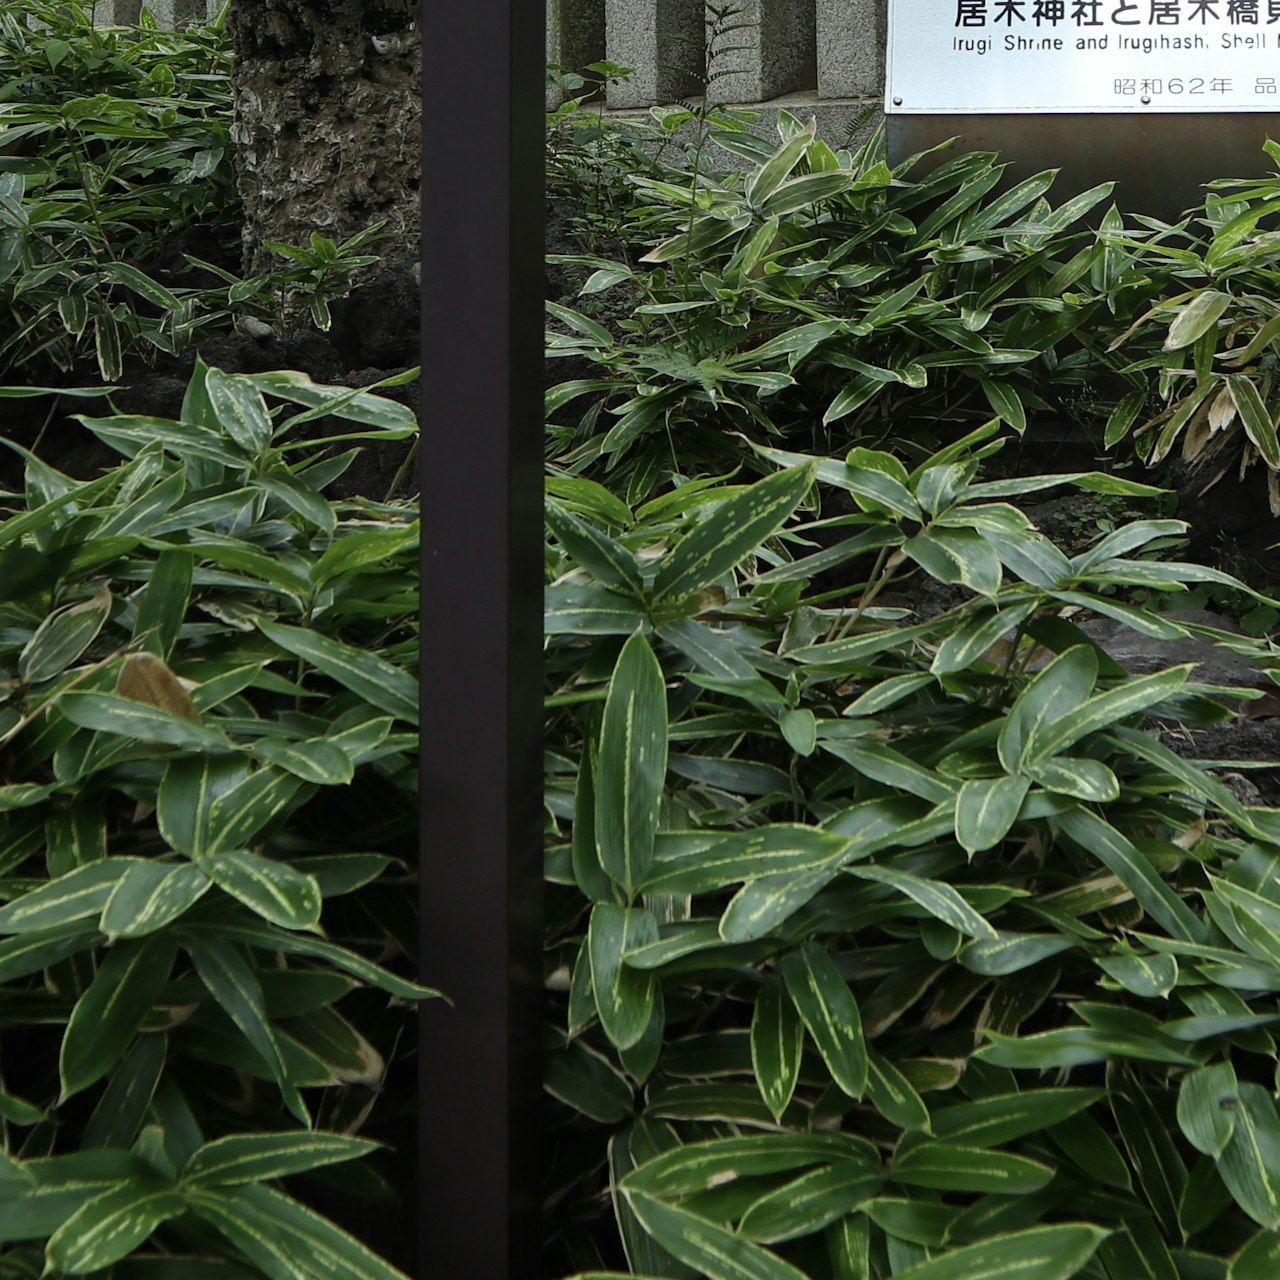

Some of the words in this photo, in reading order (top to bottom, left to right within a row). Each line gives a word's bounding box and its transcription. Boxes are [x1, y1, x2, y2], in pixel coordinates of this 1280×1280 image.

[953, 35, 992, 55] Irugi
[1076, 34, 1108, 50] and
[1221, 32, 1266, 49] Shell
[1114, 77, 1233, 96] 昭和62年
